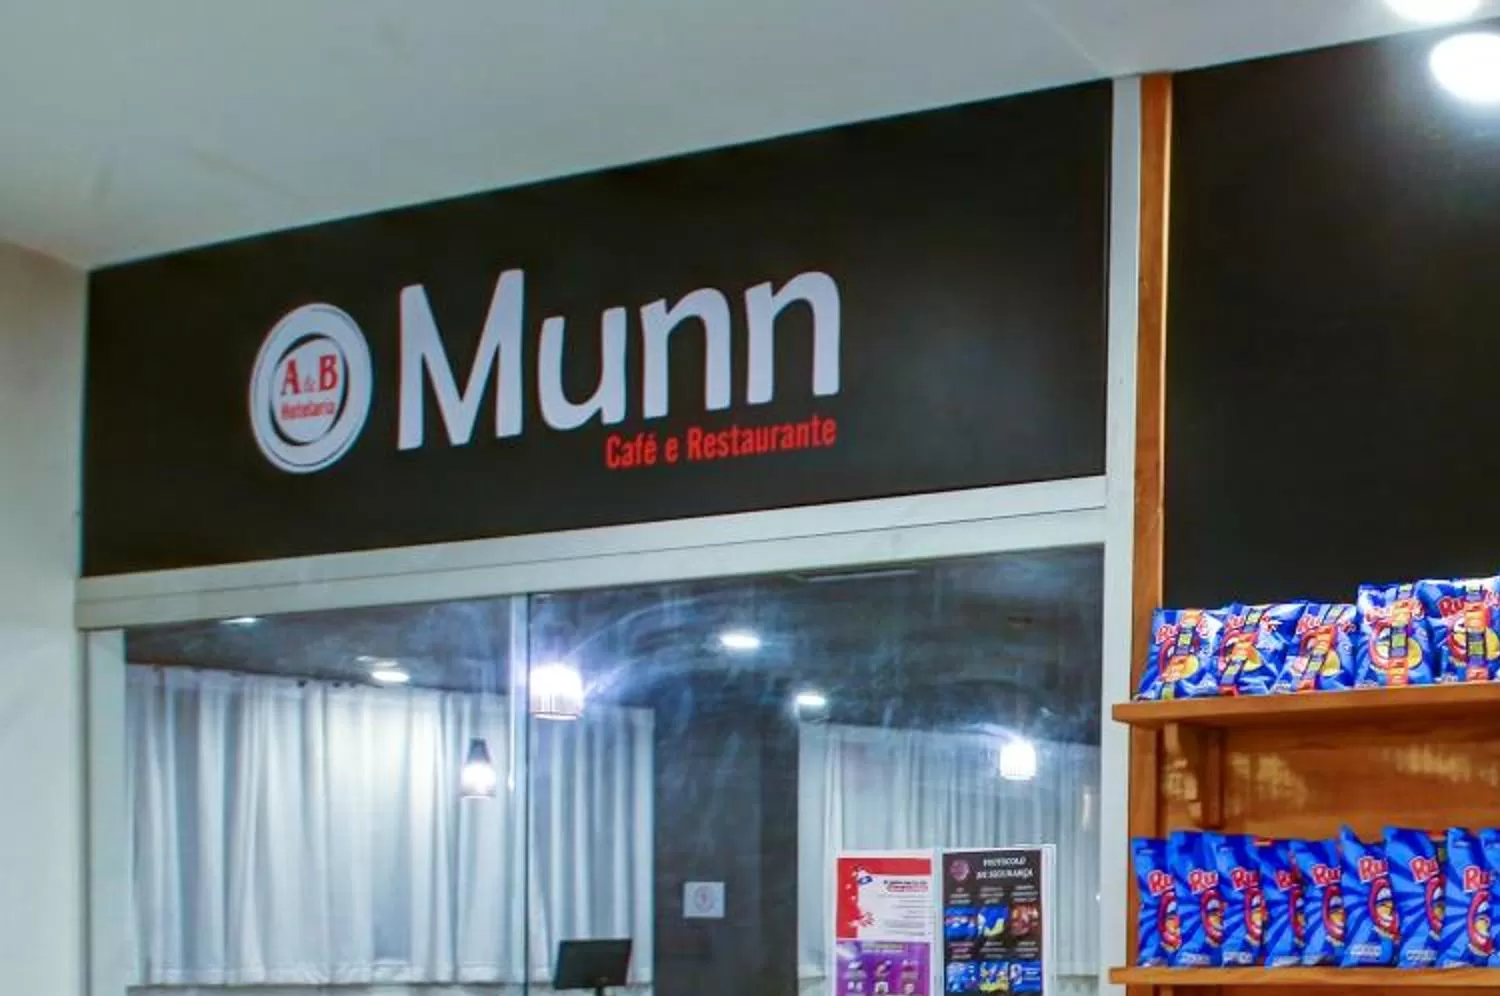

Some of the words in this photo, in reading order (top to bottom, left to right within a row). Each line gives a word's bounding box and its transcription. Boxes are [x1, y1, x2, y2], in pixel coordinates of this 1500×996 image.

[397, 269, 841, 451] Munn
[605, 430, 657, 469] Café
[666, 440, 680, 464] e
[686, 415, 837, 459] Restaurante
